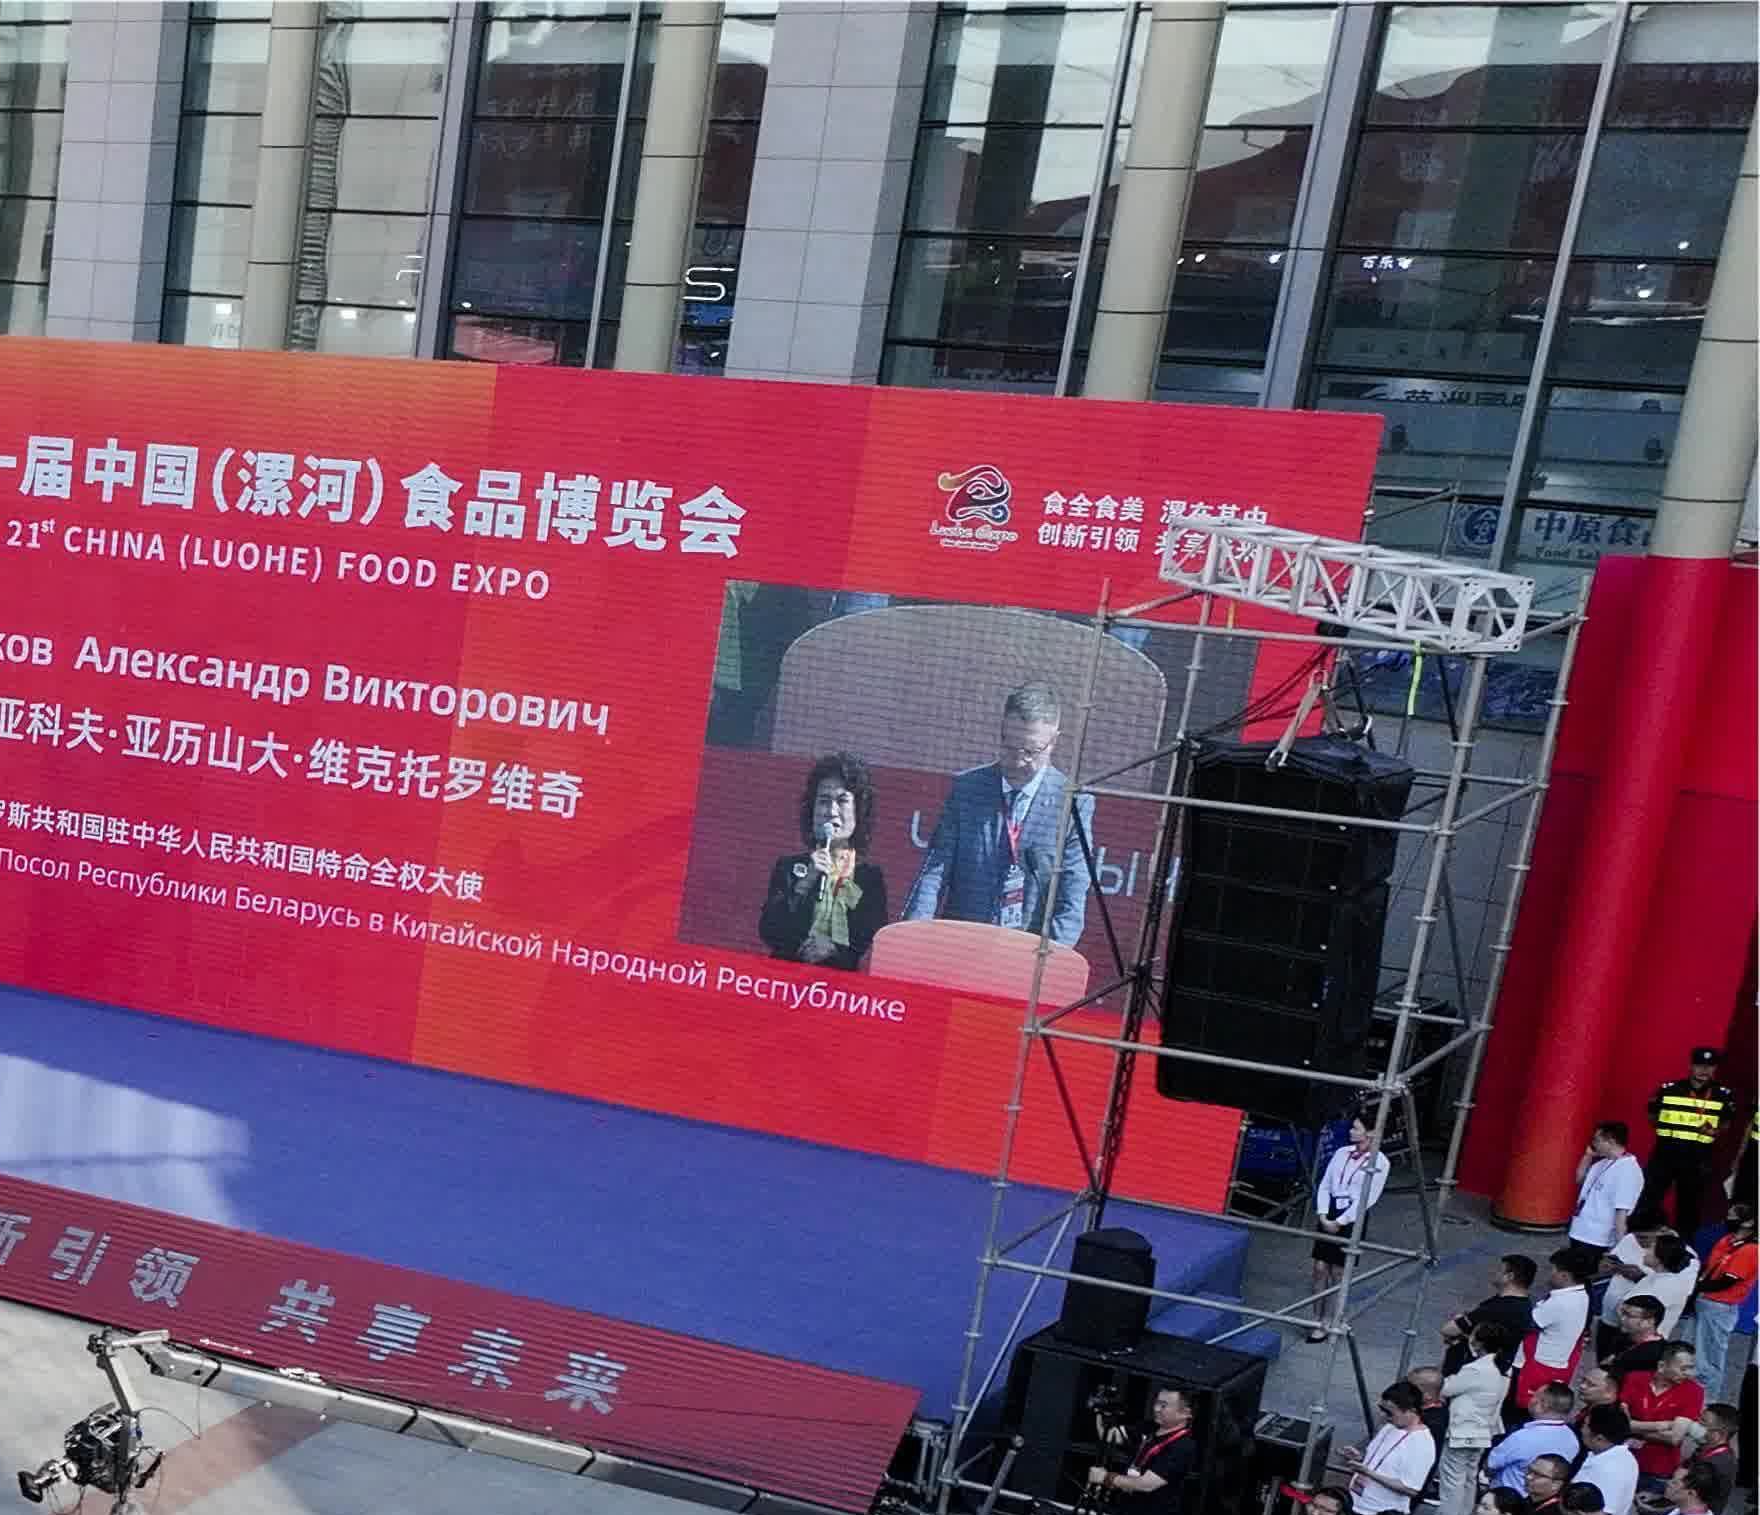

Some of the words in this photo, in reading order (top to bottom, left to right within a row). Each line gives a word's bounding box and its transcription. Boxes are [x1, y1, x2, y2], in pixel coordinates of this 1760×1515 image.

[1038, 522, 1142, 554] 创新引领
[1042, 491, 1145, 524] 食全食美
[6, 516, 57, 552] 21st
[63, 525, 166, 563] CHINA
[178, 540, 324, 584] (LUOHE)
[336, 551, 438, 591] FOOD
[450, 563, 550, 601] EXPO
[74, 636, 311, 704] Александр
[322, 663, 611, 737] Викторович
[77, 861, 228, 912] Республики
[234, 886, 362, 934] Беларусь
[368, 913, 385, 935] в
[392, 912, 544, 961] Китайской
[552, 939, 708, 989] Народной
[716, 966, 907, 1023] Республике
[258, 1277, 630, 1417] 共享未来
